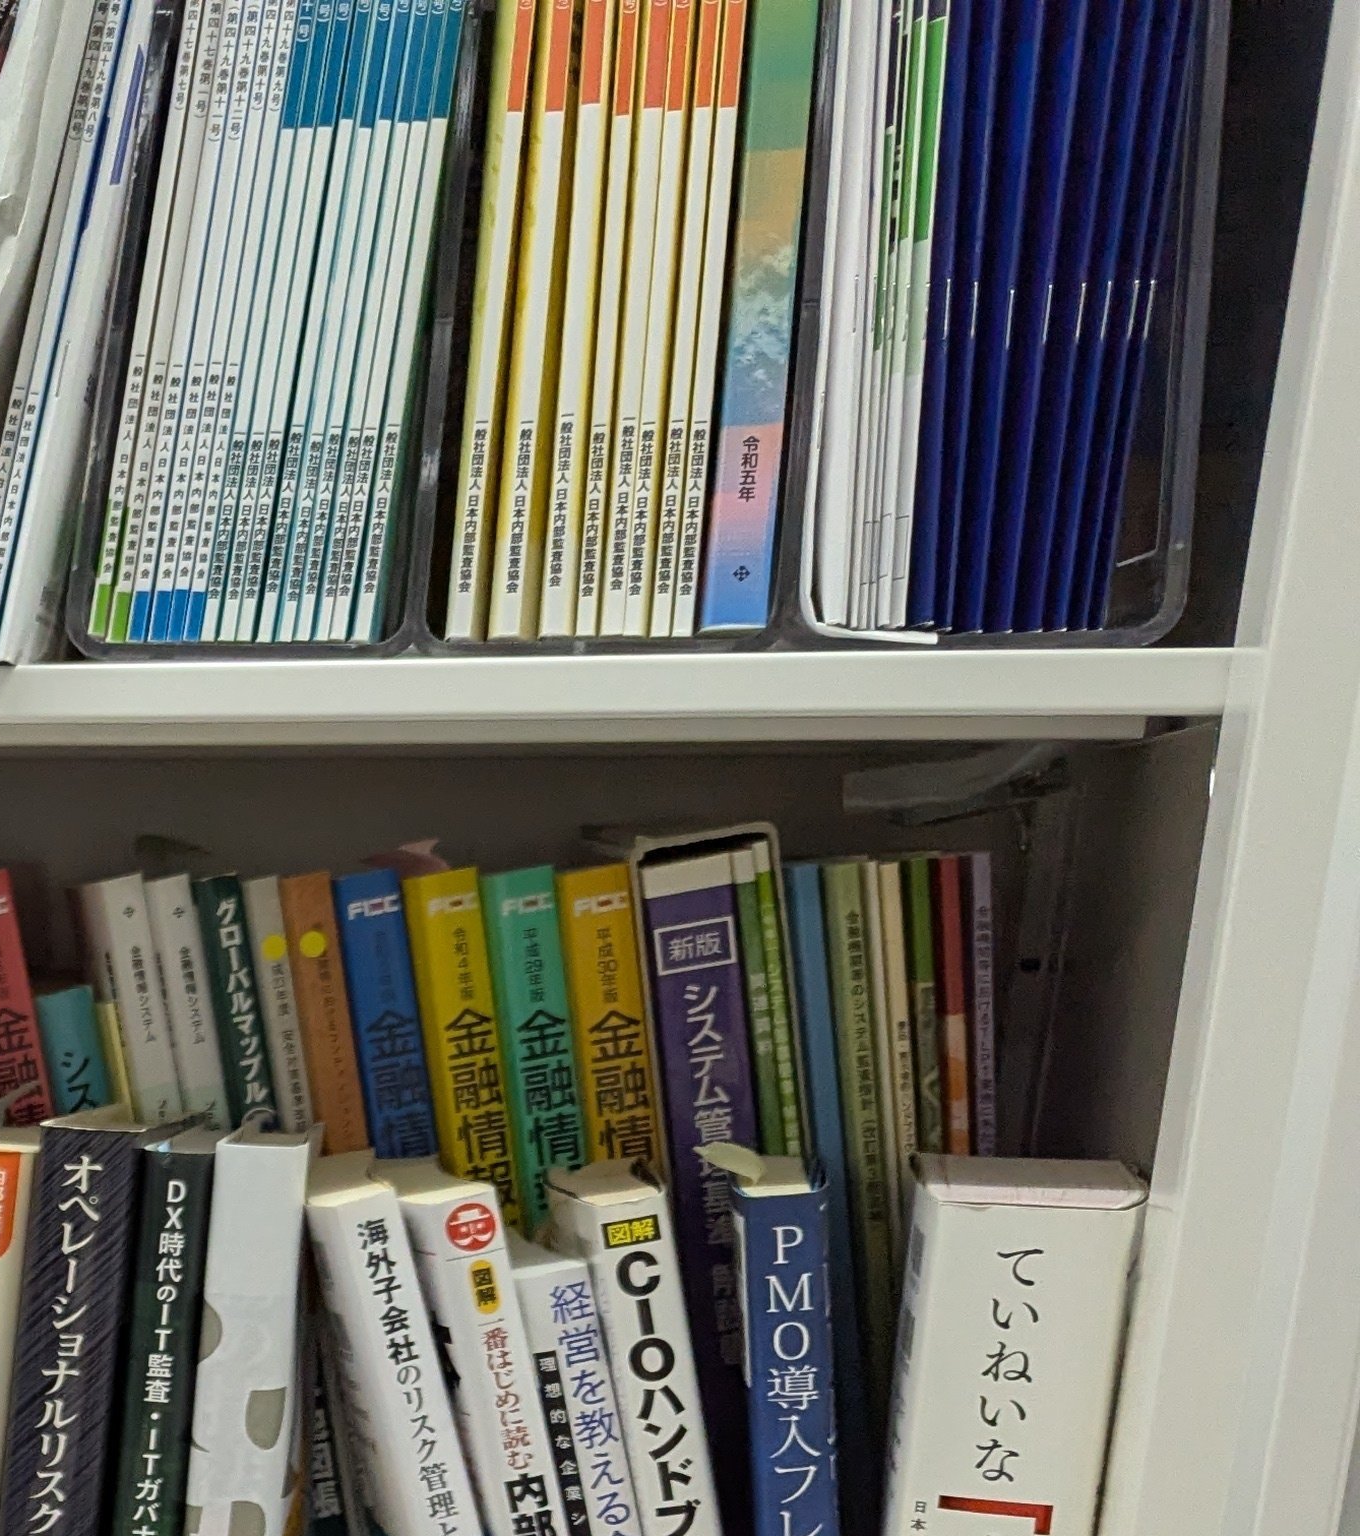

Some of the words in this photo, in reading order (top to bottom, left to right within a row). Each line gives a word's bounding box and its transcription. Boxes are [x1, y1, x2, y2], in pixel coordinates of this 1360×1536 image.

[737, 436, 761, 502] 令和五年
[668, 930, 723, 961] 新版
[606, 1220, 656, 1246] 図解
[479, 1317, 535, 1471] 一番はじめに読む
[974, 1245, 1047, 1482] ていねいな
